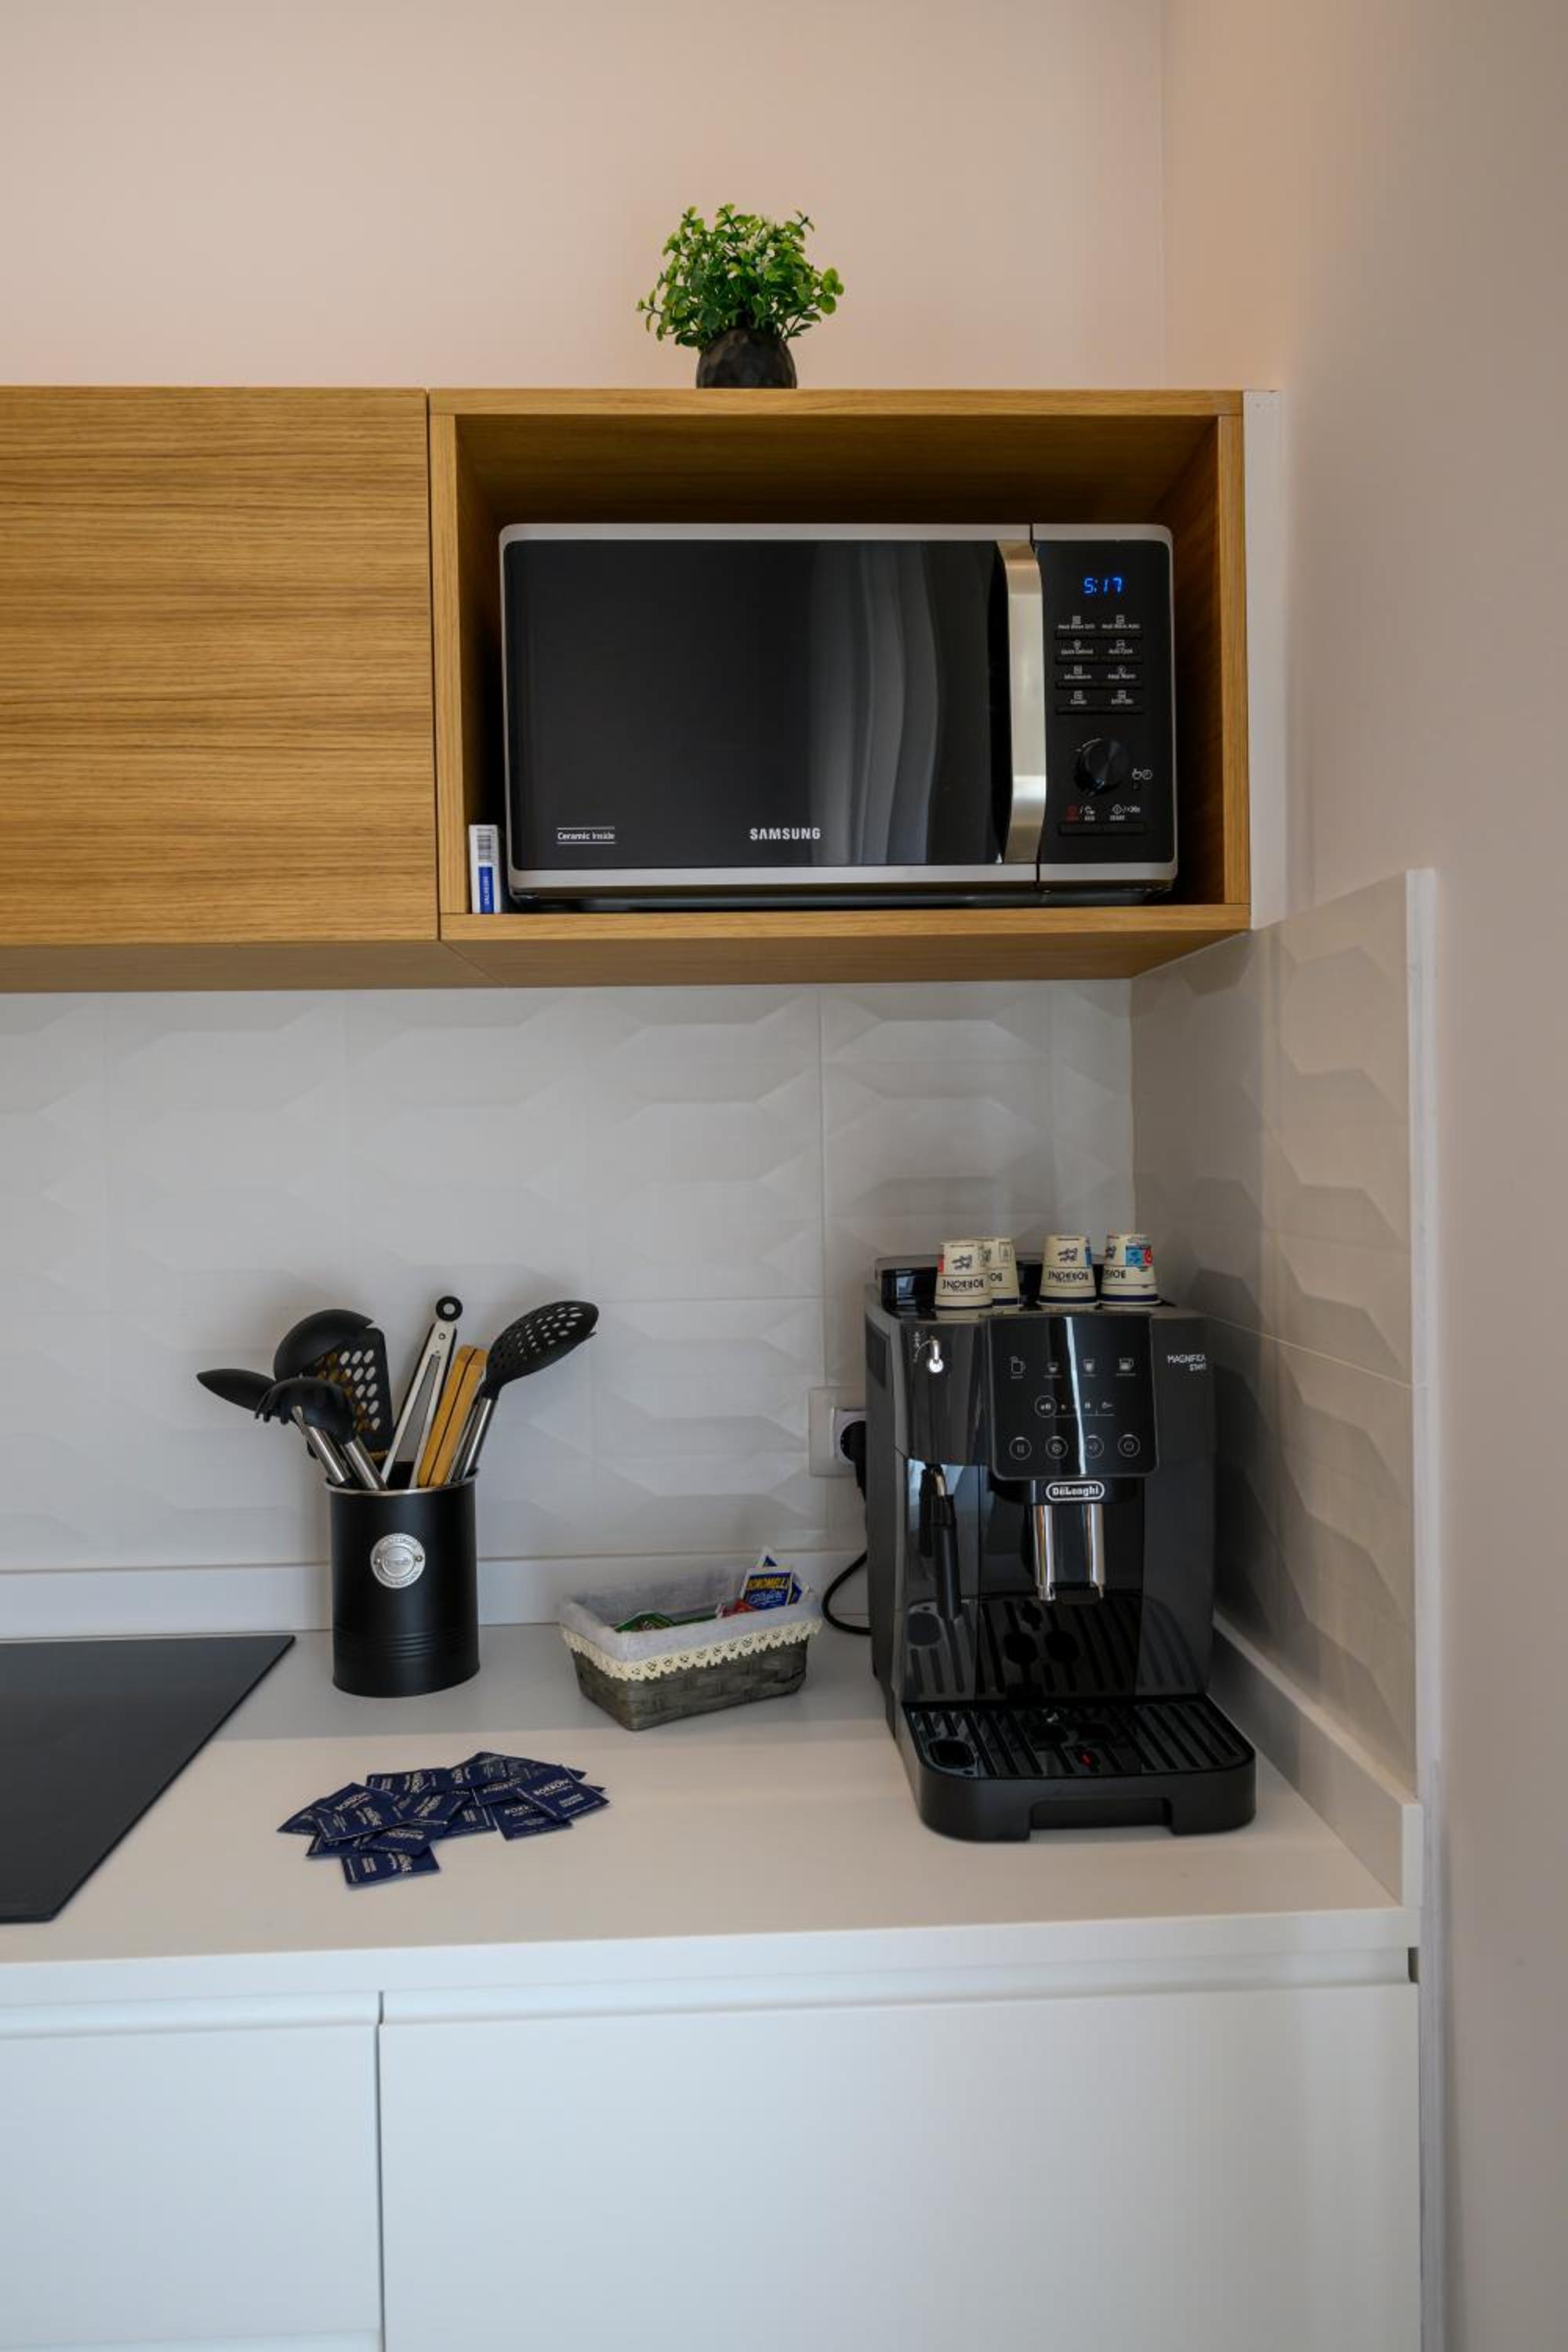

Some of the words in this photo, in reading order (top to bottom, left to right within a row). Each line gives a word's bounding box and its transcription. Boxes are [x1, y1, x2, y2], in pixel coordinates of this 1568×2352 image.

[1084, 578, 1122, 593] 5:17
[557, 831, 590, 840] Ceramic
[592, 831, 615, 840] Inside
[750, 828, 821, 840] SAMSUNG
[942, 1279, 984, 1289] BORBONE
